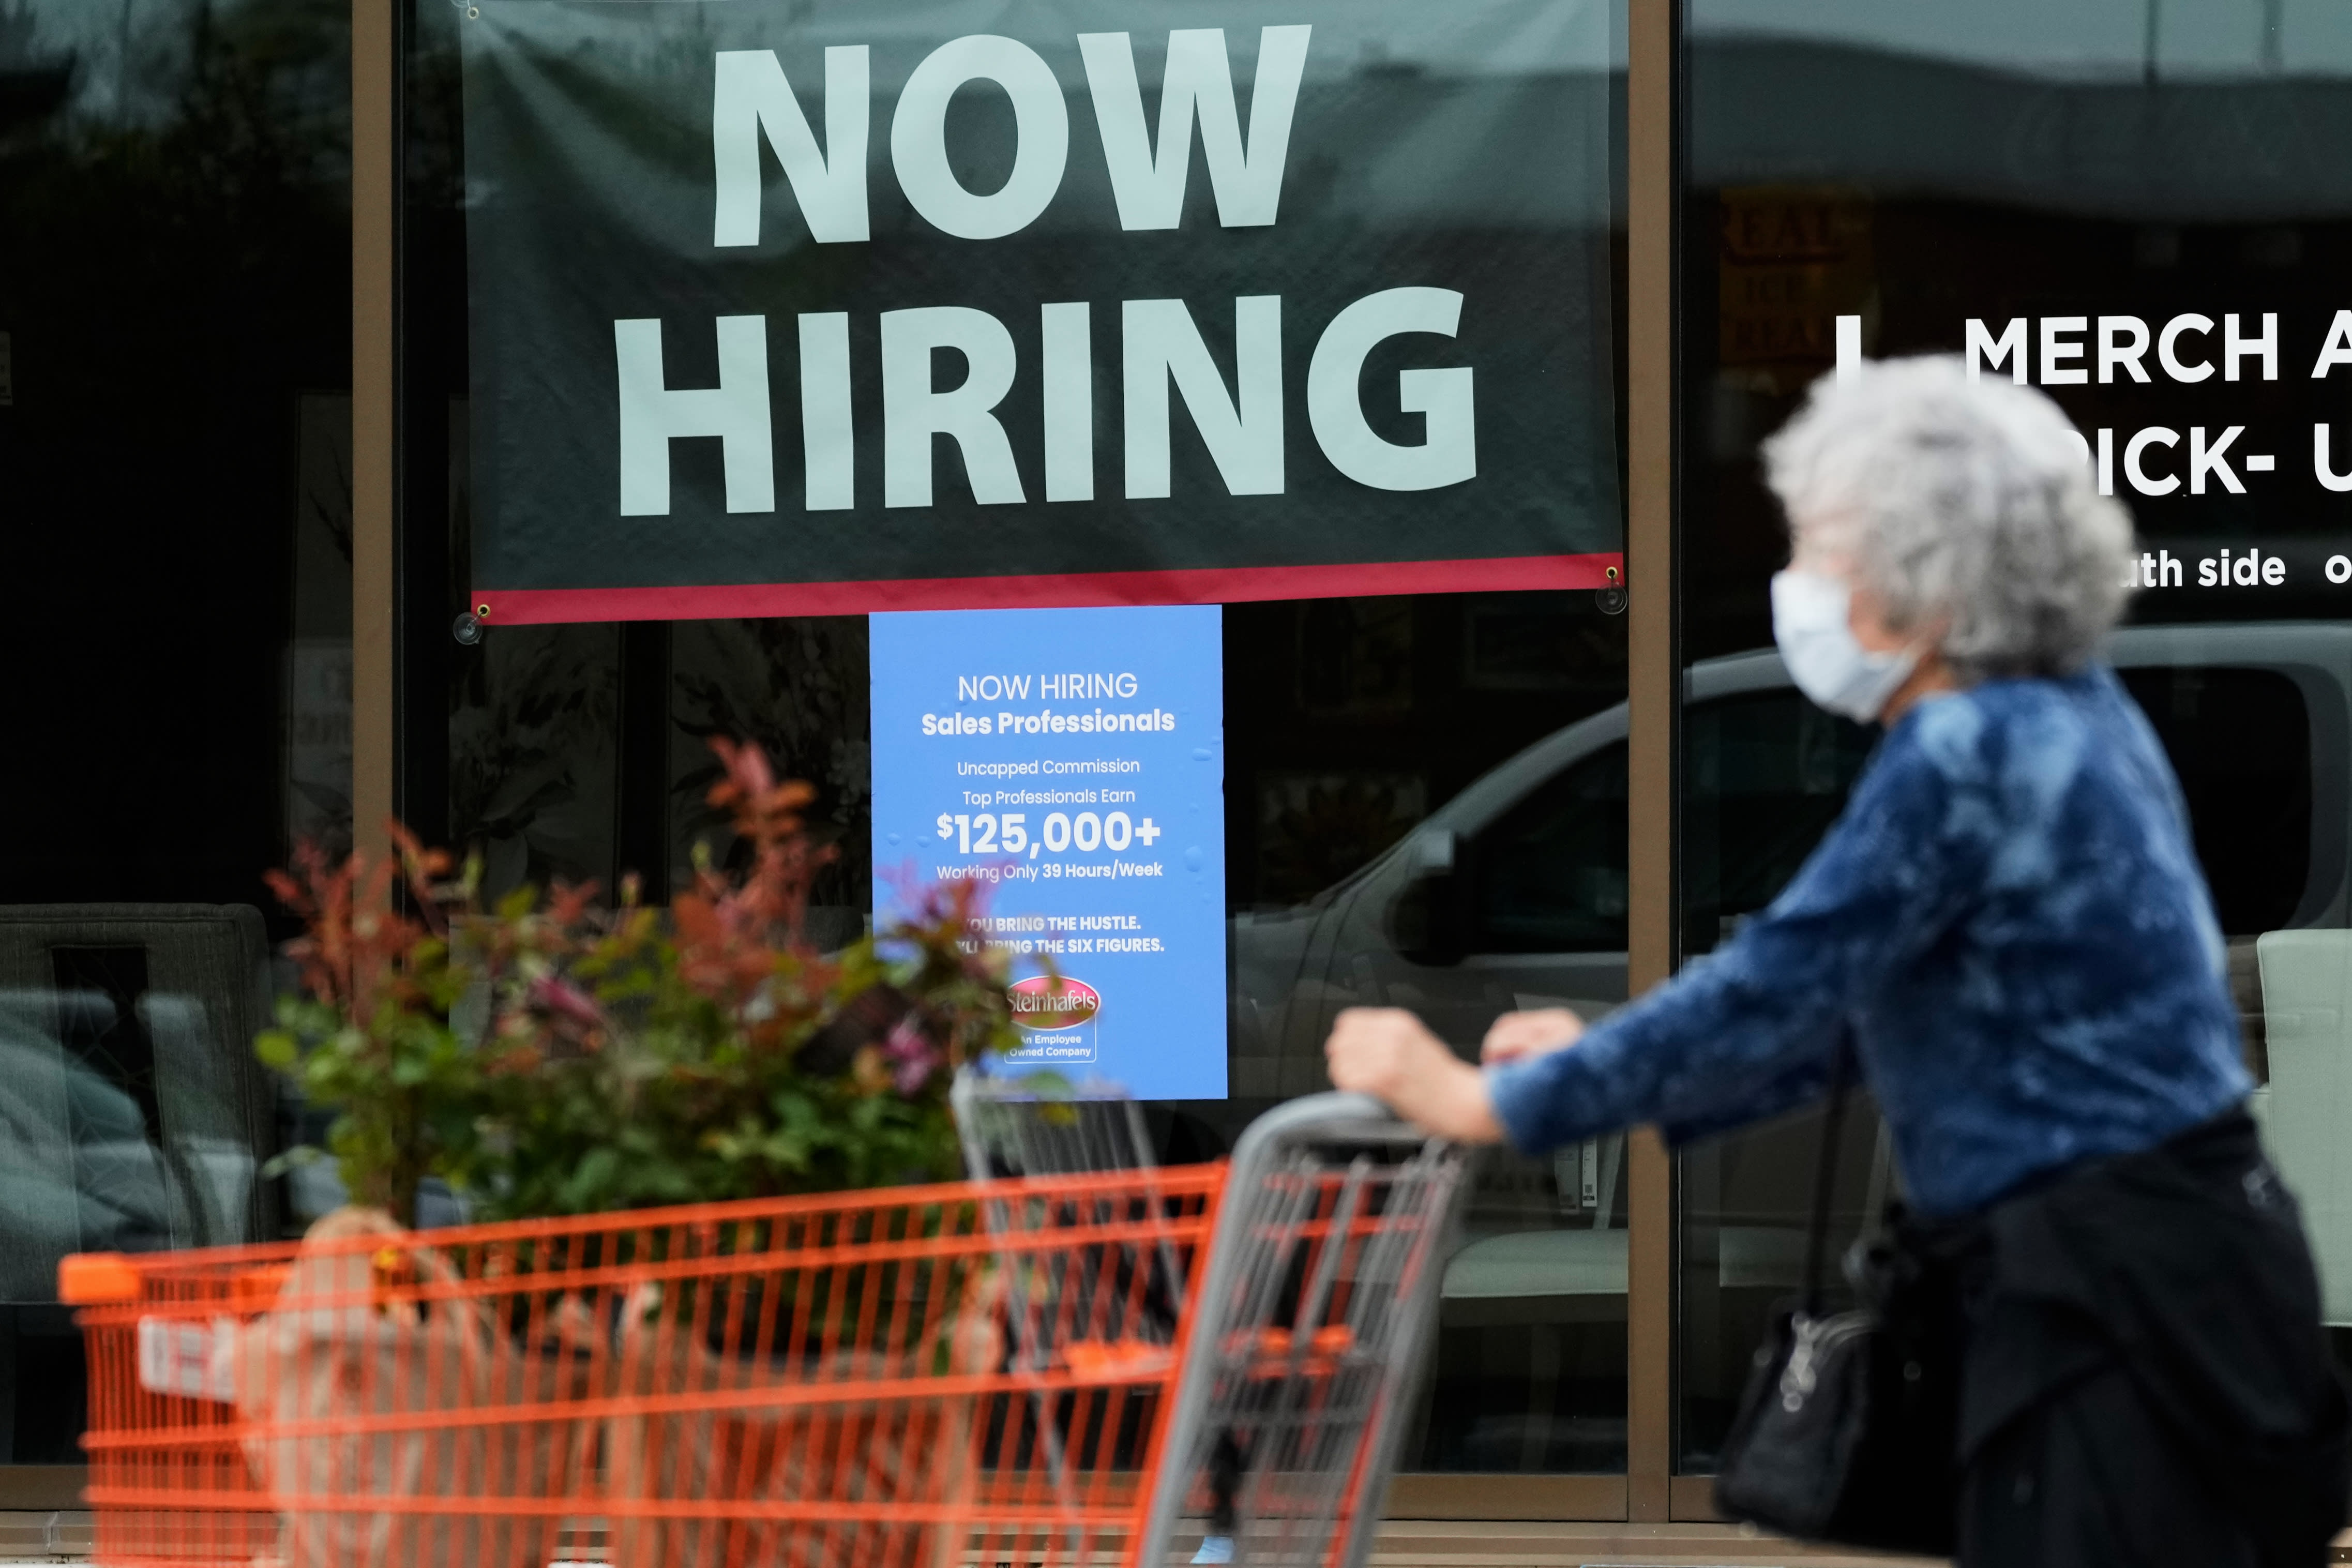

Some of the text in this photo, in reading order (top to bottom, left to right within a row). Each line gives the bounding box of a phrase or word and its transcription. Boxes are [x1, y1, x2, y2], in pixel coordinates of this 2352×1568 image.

[713, 24, 1313, 247] NOW
[1965, 313, 2278, 385] MERCH
[614, 287, 1477, 517] HIRING
[2198, 548, 2286, 587] side
[958, 672, 1138, 701] NOW HIRING
[921, 707, 1175, 736] Sales Professionals
[957, 758, 1140, 779] Uncapped Commission
[962, 789, 1136, 809] Top Professionals Earn
[936, 811, 1161, 860] $125,000+
[937, 858, 1164, 883] Working Only 39 Hours/Week
[967, 915, 1142, 932] OU BRING THE HUSTLE.
[1035, 939, 1065, 954] THE
[1067, 939, 1093, 954] SIX
[1096, 937, 1165, 953] FIGURES.
[1009, 1047, 1092, 1058] Owned Company
[1034, 1034, 1082, 1045] Employee
